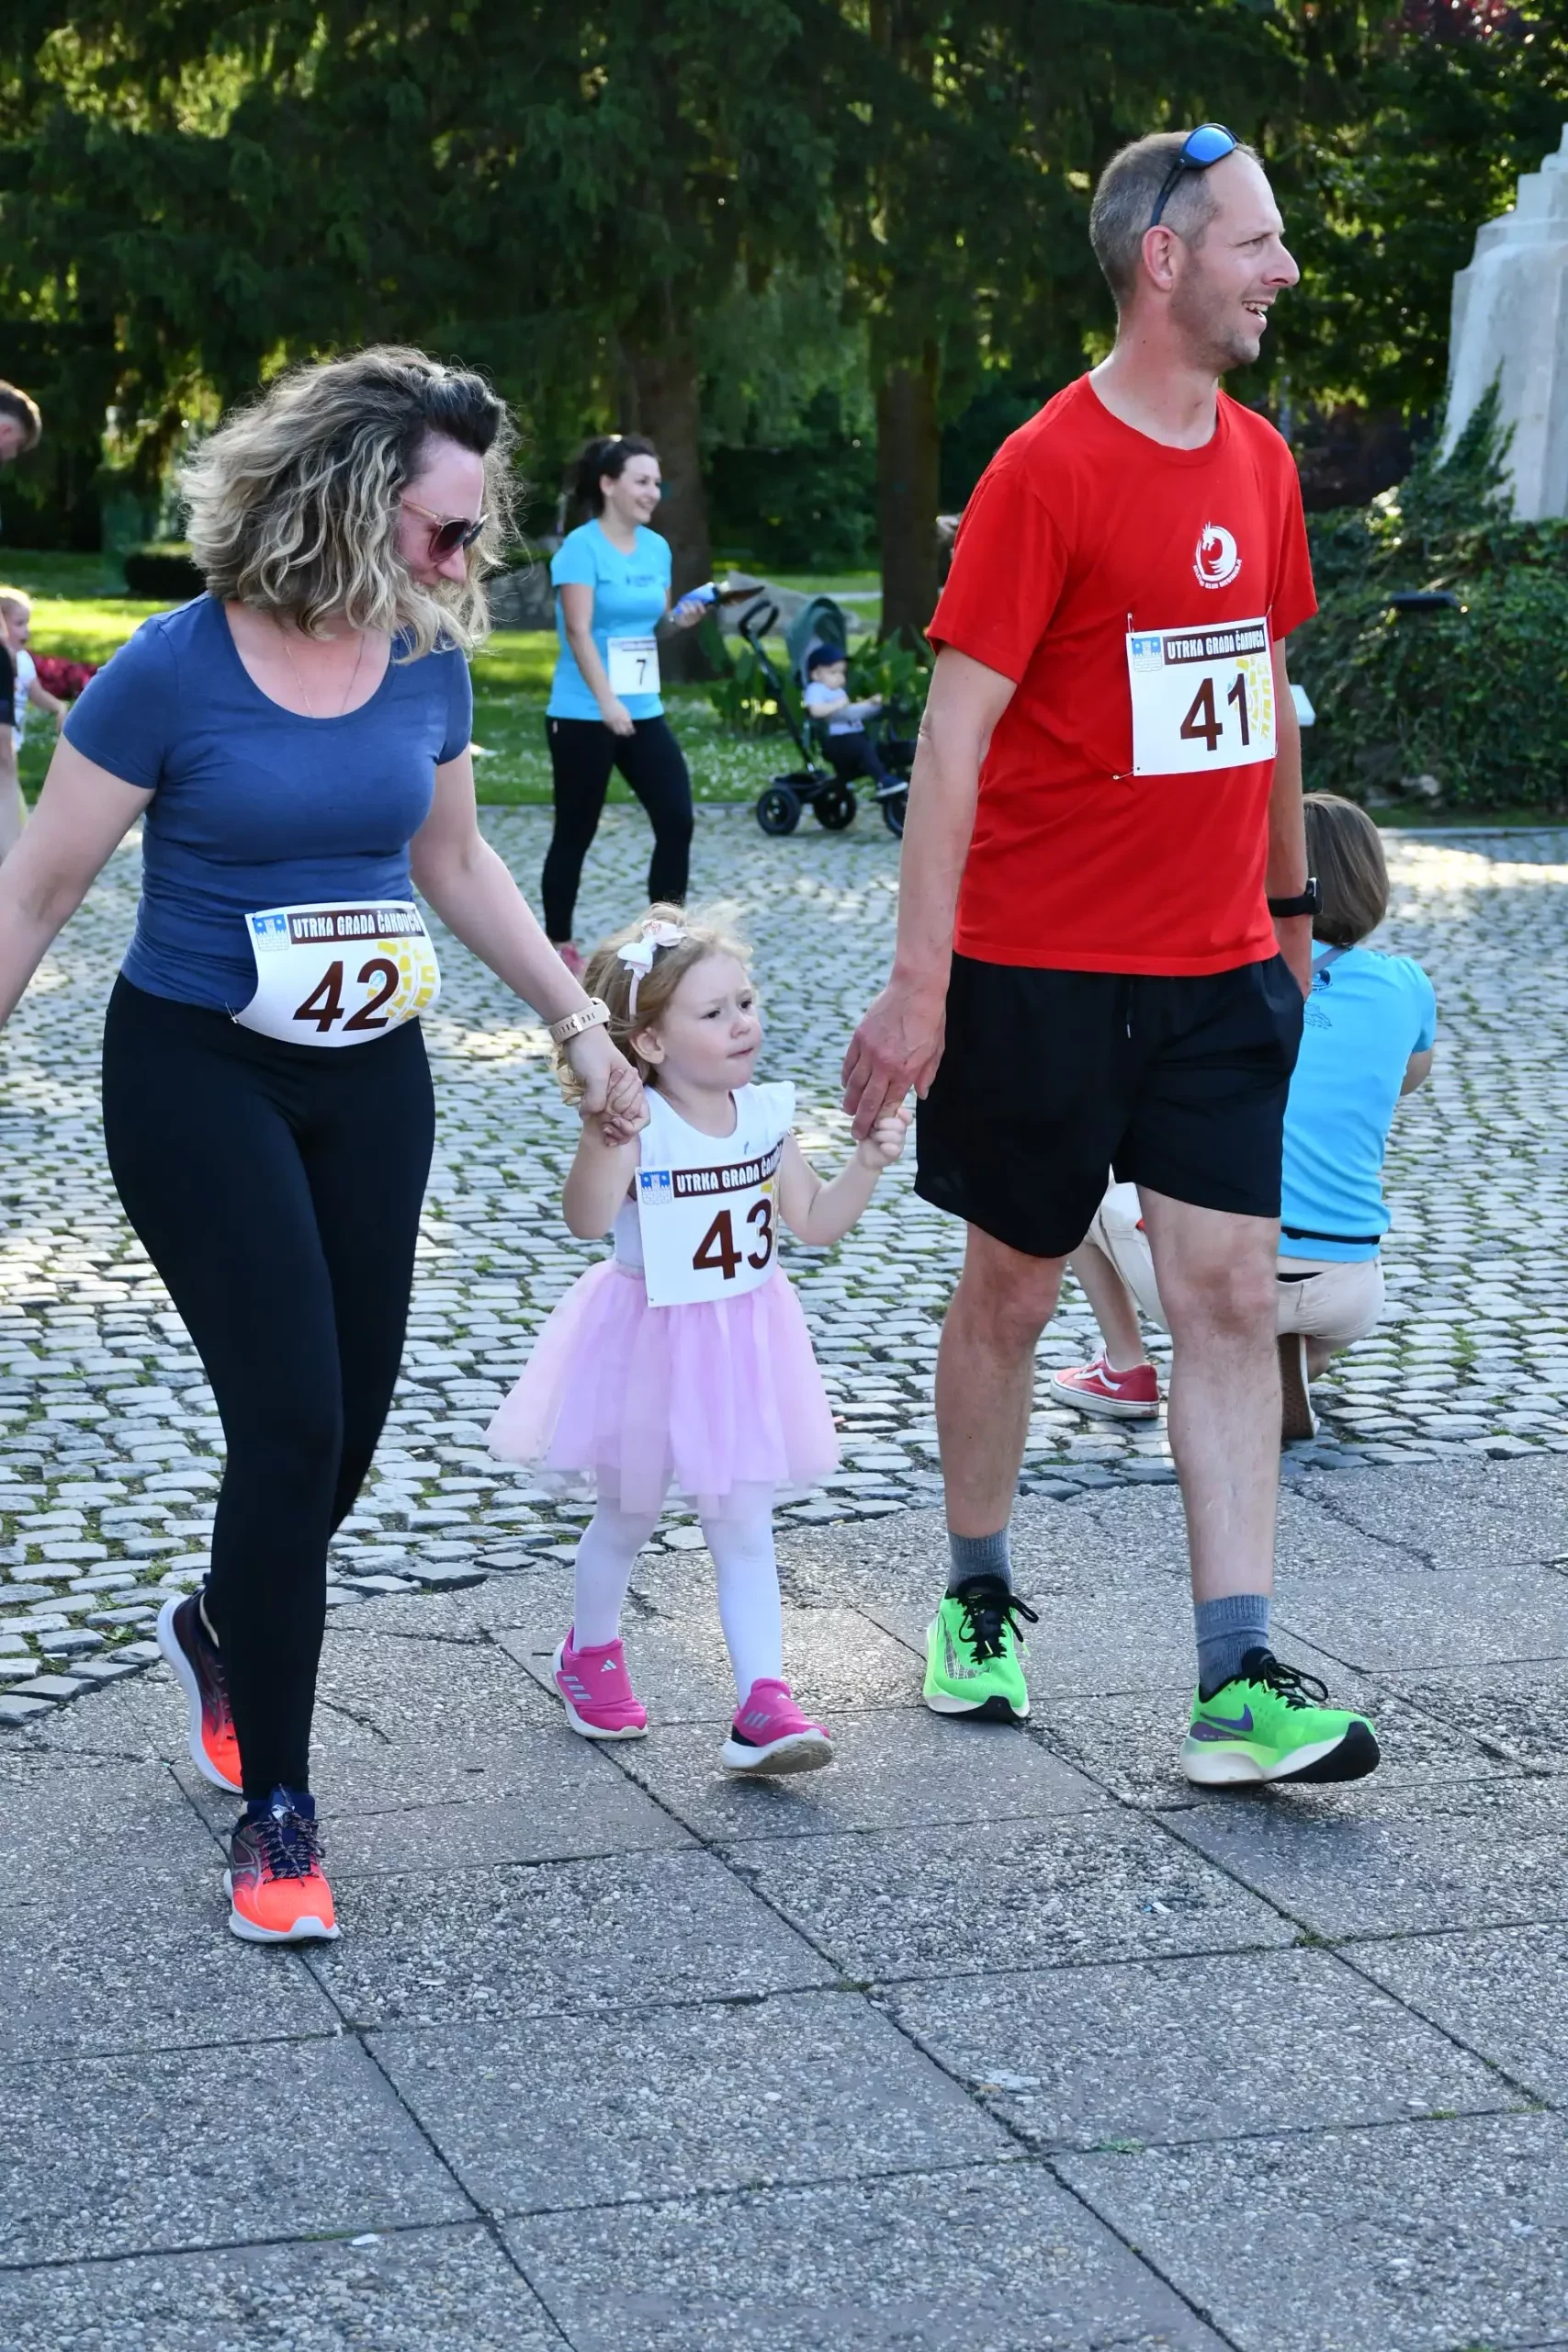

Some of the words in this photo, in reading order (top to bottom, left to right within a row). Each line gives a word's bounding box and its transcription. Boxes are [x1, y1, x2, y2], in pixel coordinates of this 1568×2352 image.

[1167, 638, 1204, 660] UTRKA
[1205, 635, 1236, 656] GRADA
[636, 659, 647, 685] 7
[1179, 673, 1250, 752] 41
[292, 915, 334, 939] UTRKA
[337, 913, 376, 936] GRADA
[292, 958, 400, 1033] 42
[676, 1170, 719, 1193] UTRKA
[722, 1164, 761, 1188] GRADA
[693, 1198, 773, 1280] 43
